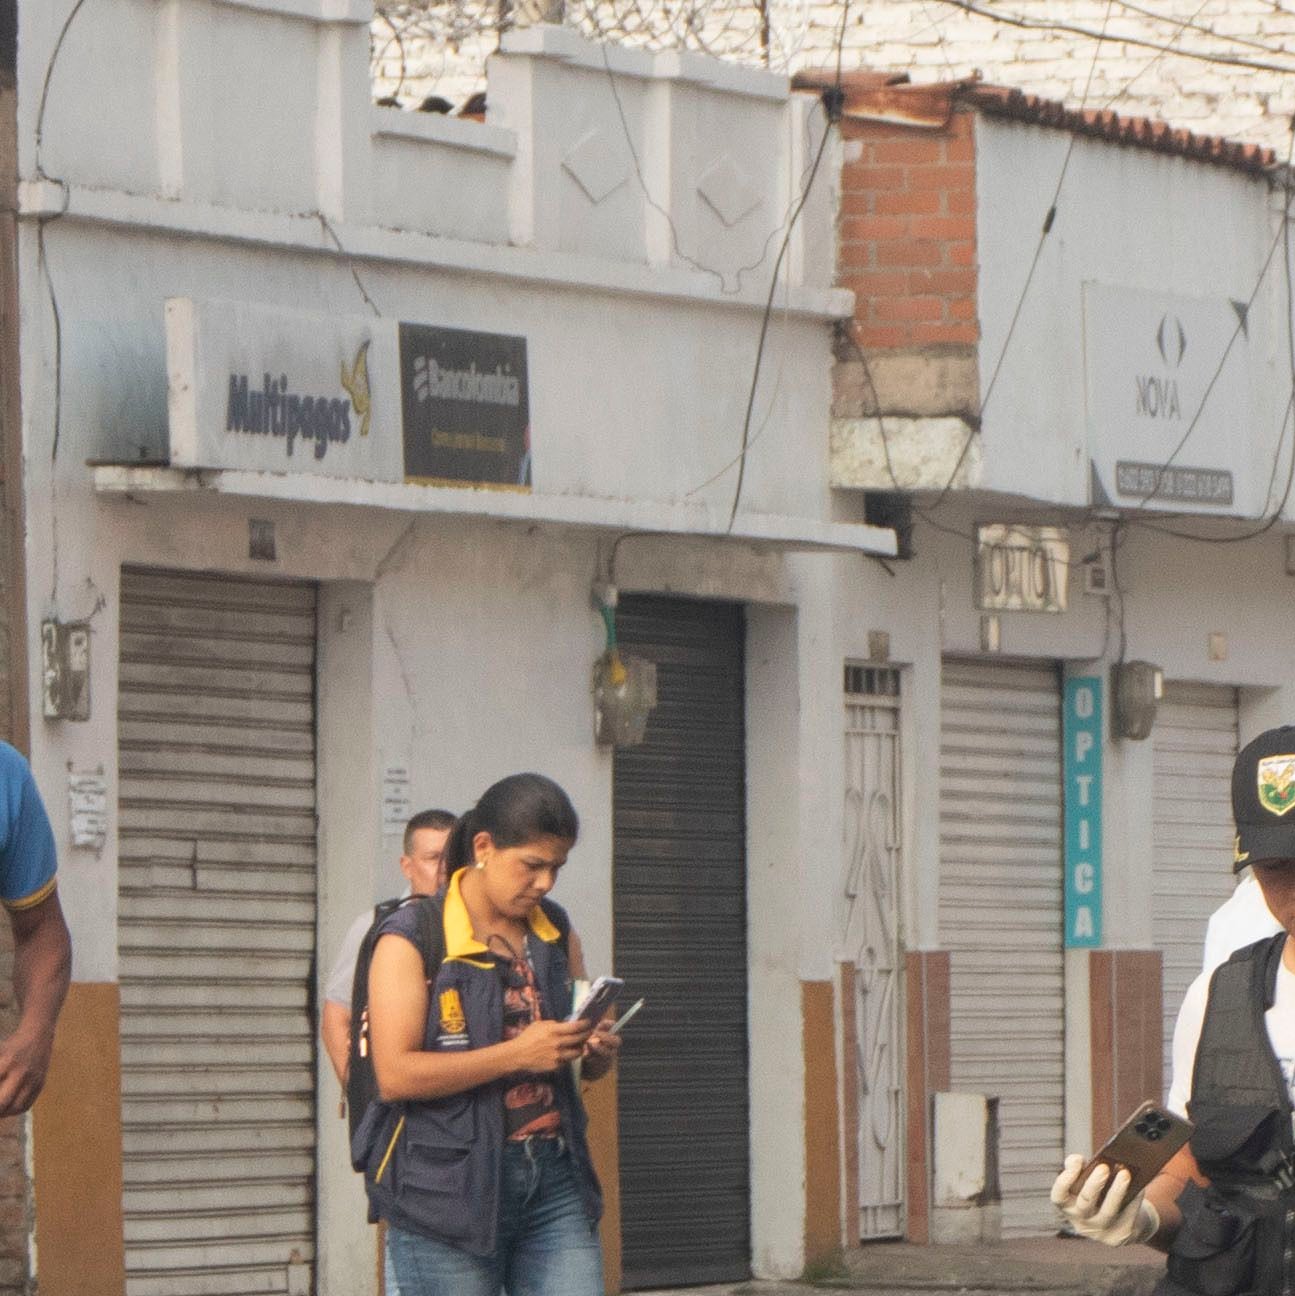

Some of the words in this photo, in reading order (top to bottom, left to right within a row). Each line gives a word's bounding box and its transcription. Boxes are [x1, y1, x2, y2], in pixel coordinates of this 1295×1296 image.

[226, 373, 350, 459] Multipagos
[1136, 375, 1181, 420] NOVA
[1073, 687, 1095, 938] OPTICA
